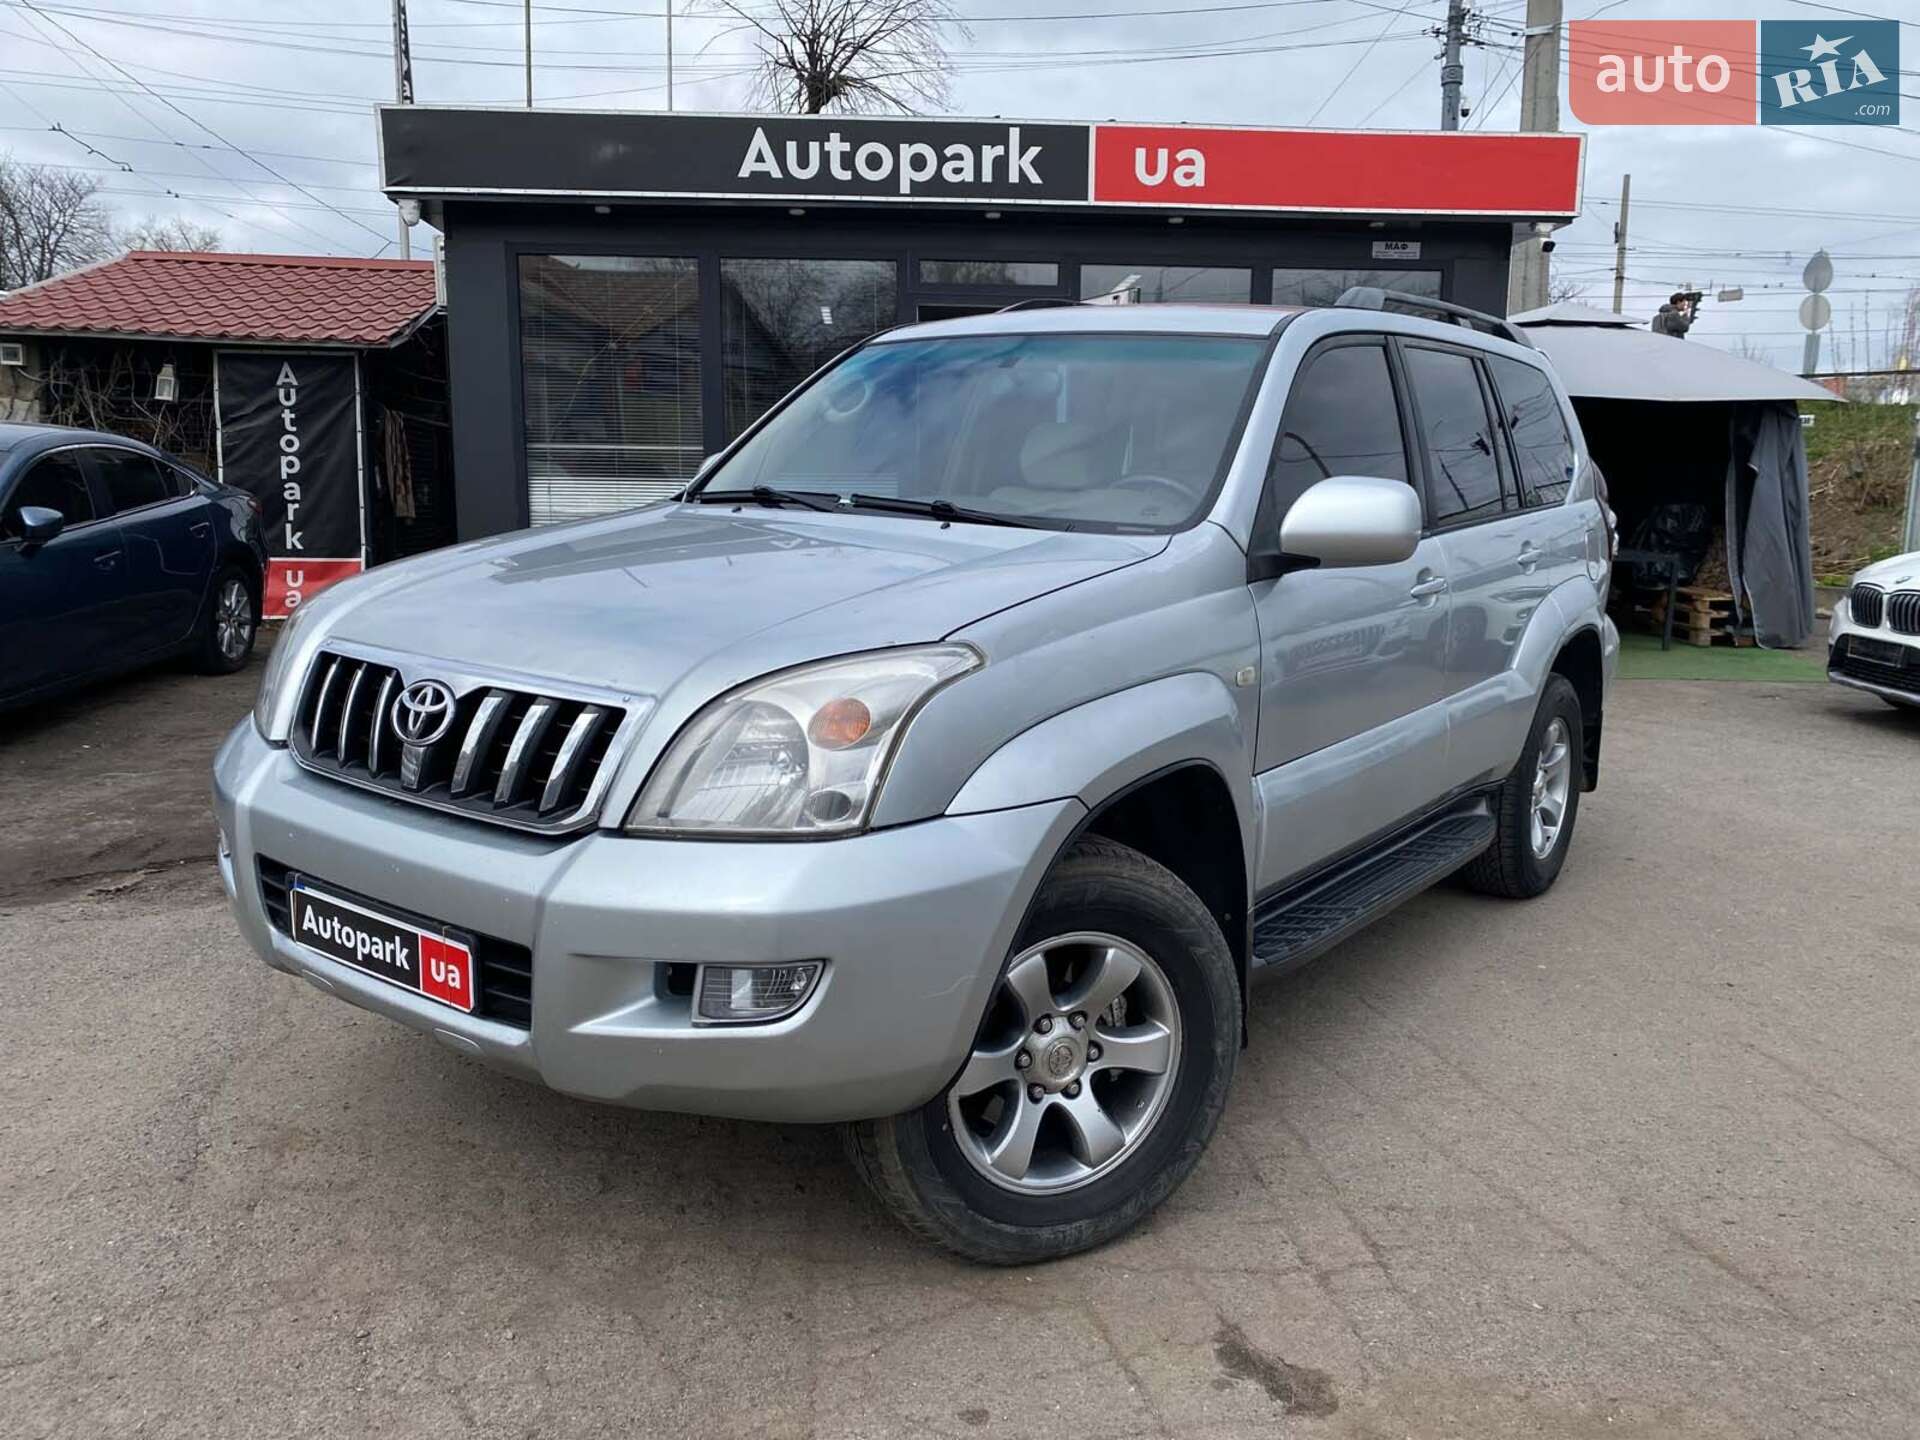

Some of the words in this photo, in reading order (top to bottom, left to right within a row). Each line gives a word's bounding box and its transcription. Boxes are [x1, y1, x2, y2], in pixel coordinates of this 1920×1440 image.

[737, 127, 1043, 194] Autopark
[1134, 147, 1206, 187] ua
[275, 361, 304, 550] Autopark
[284, 570, 304, 608] ua
[302, 905, 410, 970] Autopark
[430, 957, 461, 989] ua
